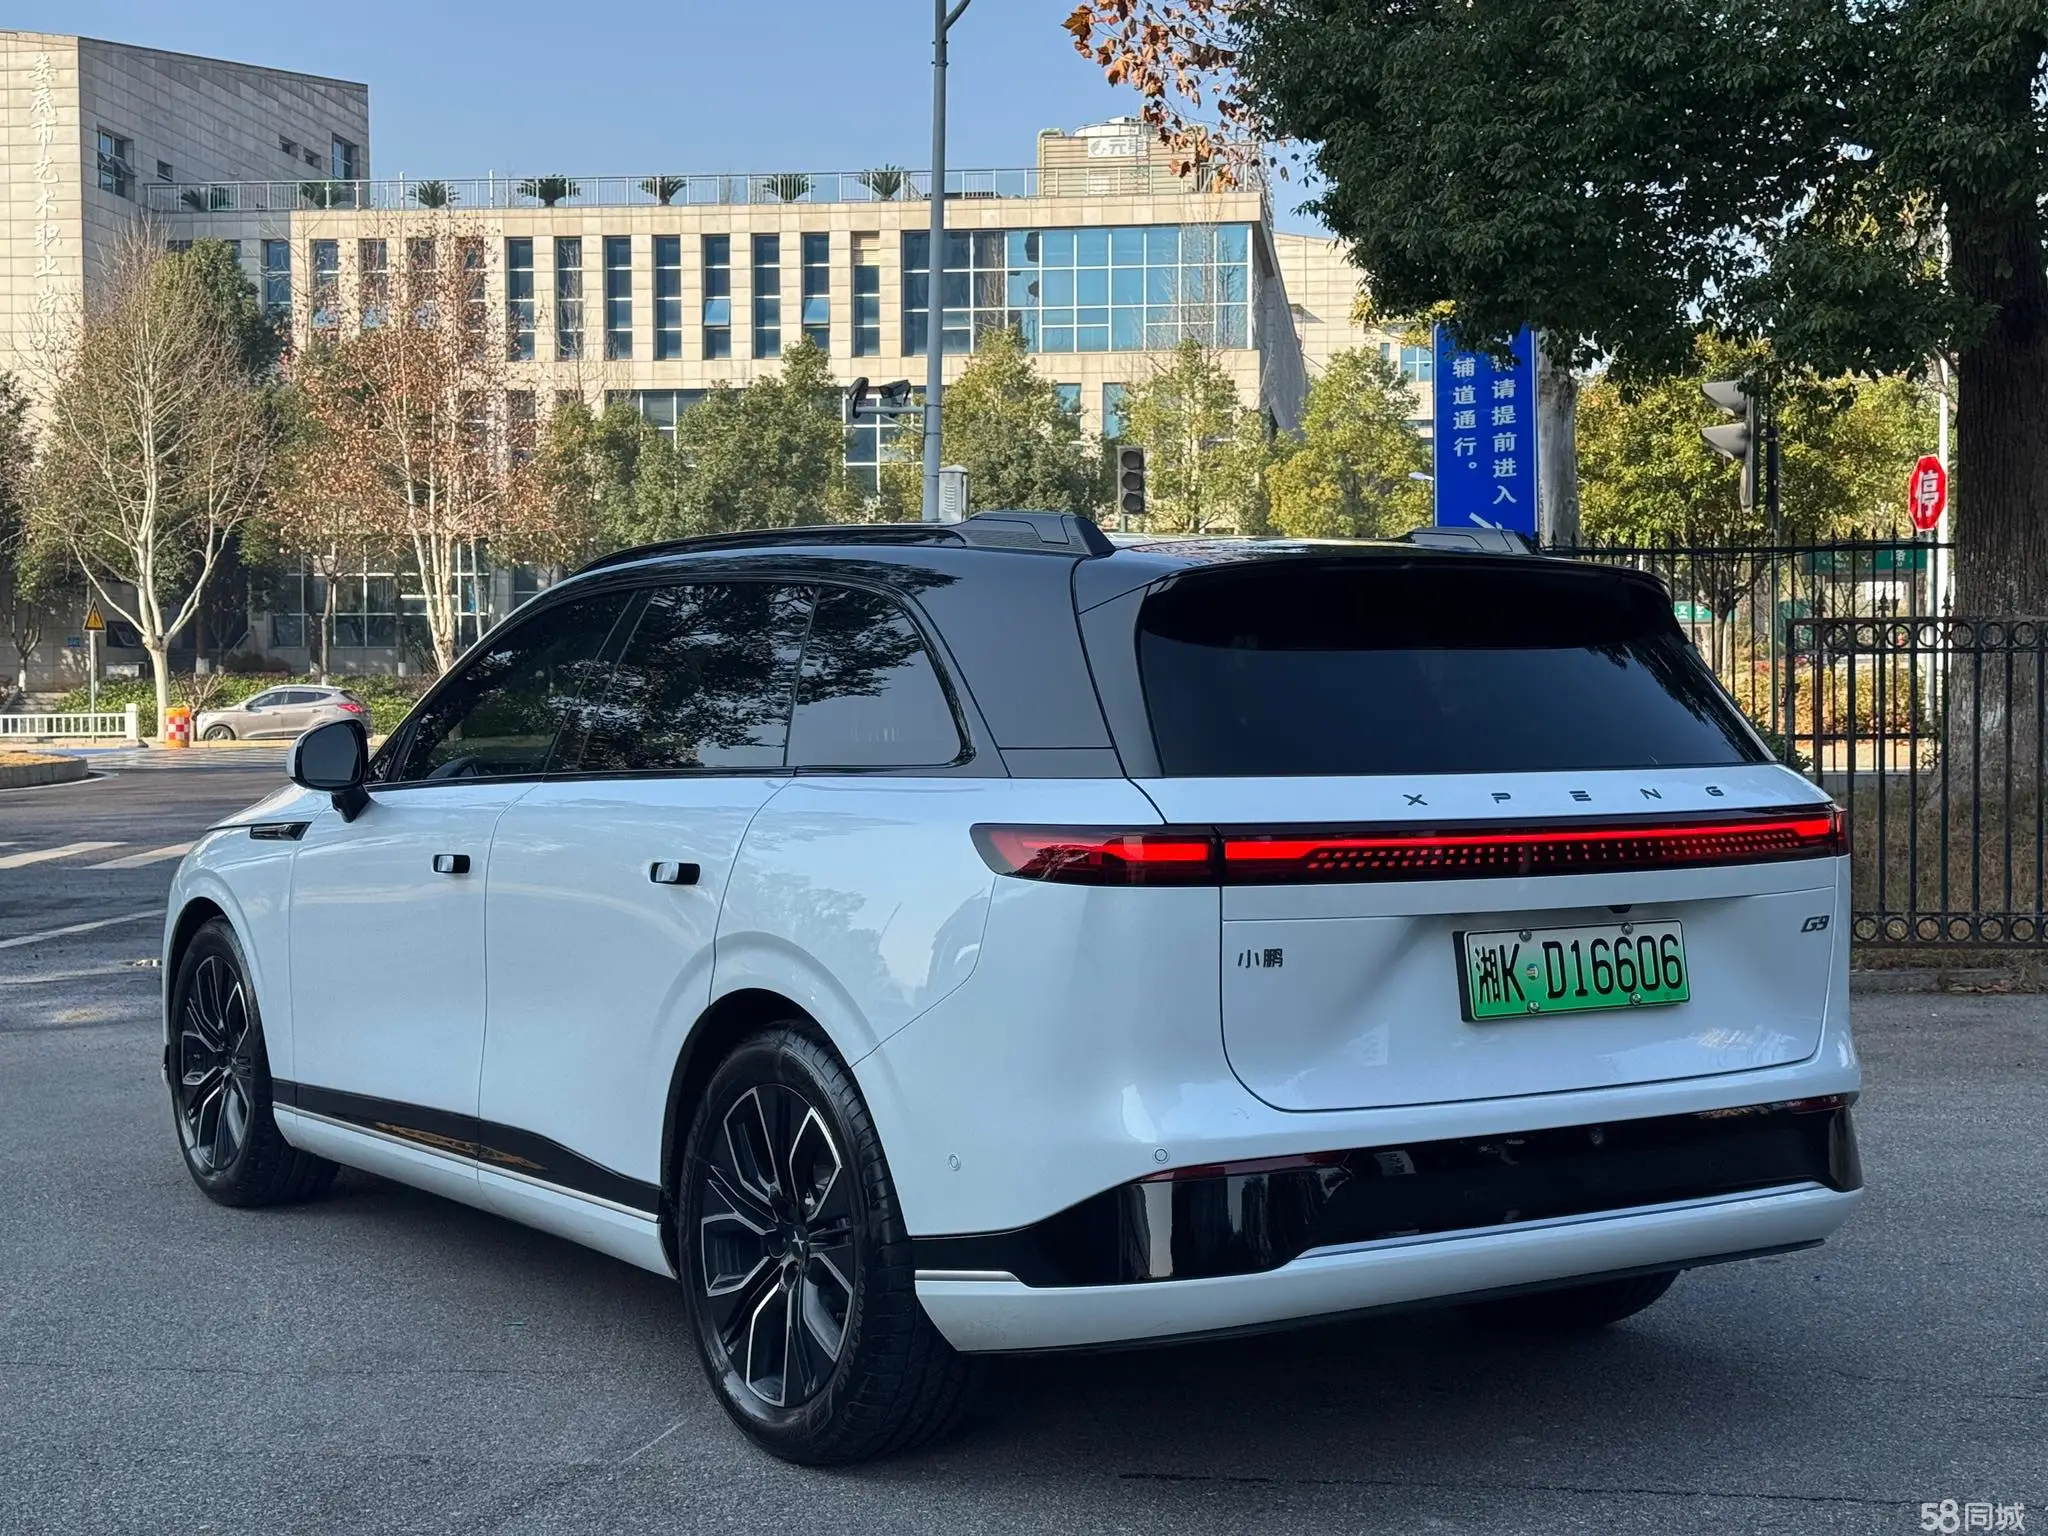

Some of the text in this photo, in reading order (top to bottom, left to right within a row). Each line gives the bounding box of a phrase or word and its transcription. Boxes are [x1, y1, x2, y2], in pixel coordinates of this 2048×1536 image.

[1915, 470, 1939, 518] 停
[1403, 785, 1725, 806] XPENG
[1800, 914, 1830, 933] G9
[1238, 948, 1283, 968] 小鹏
